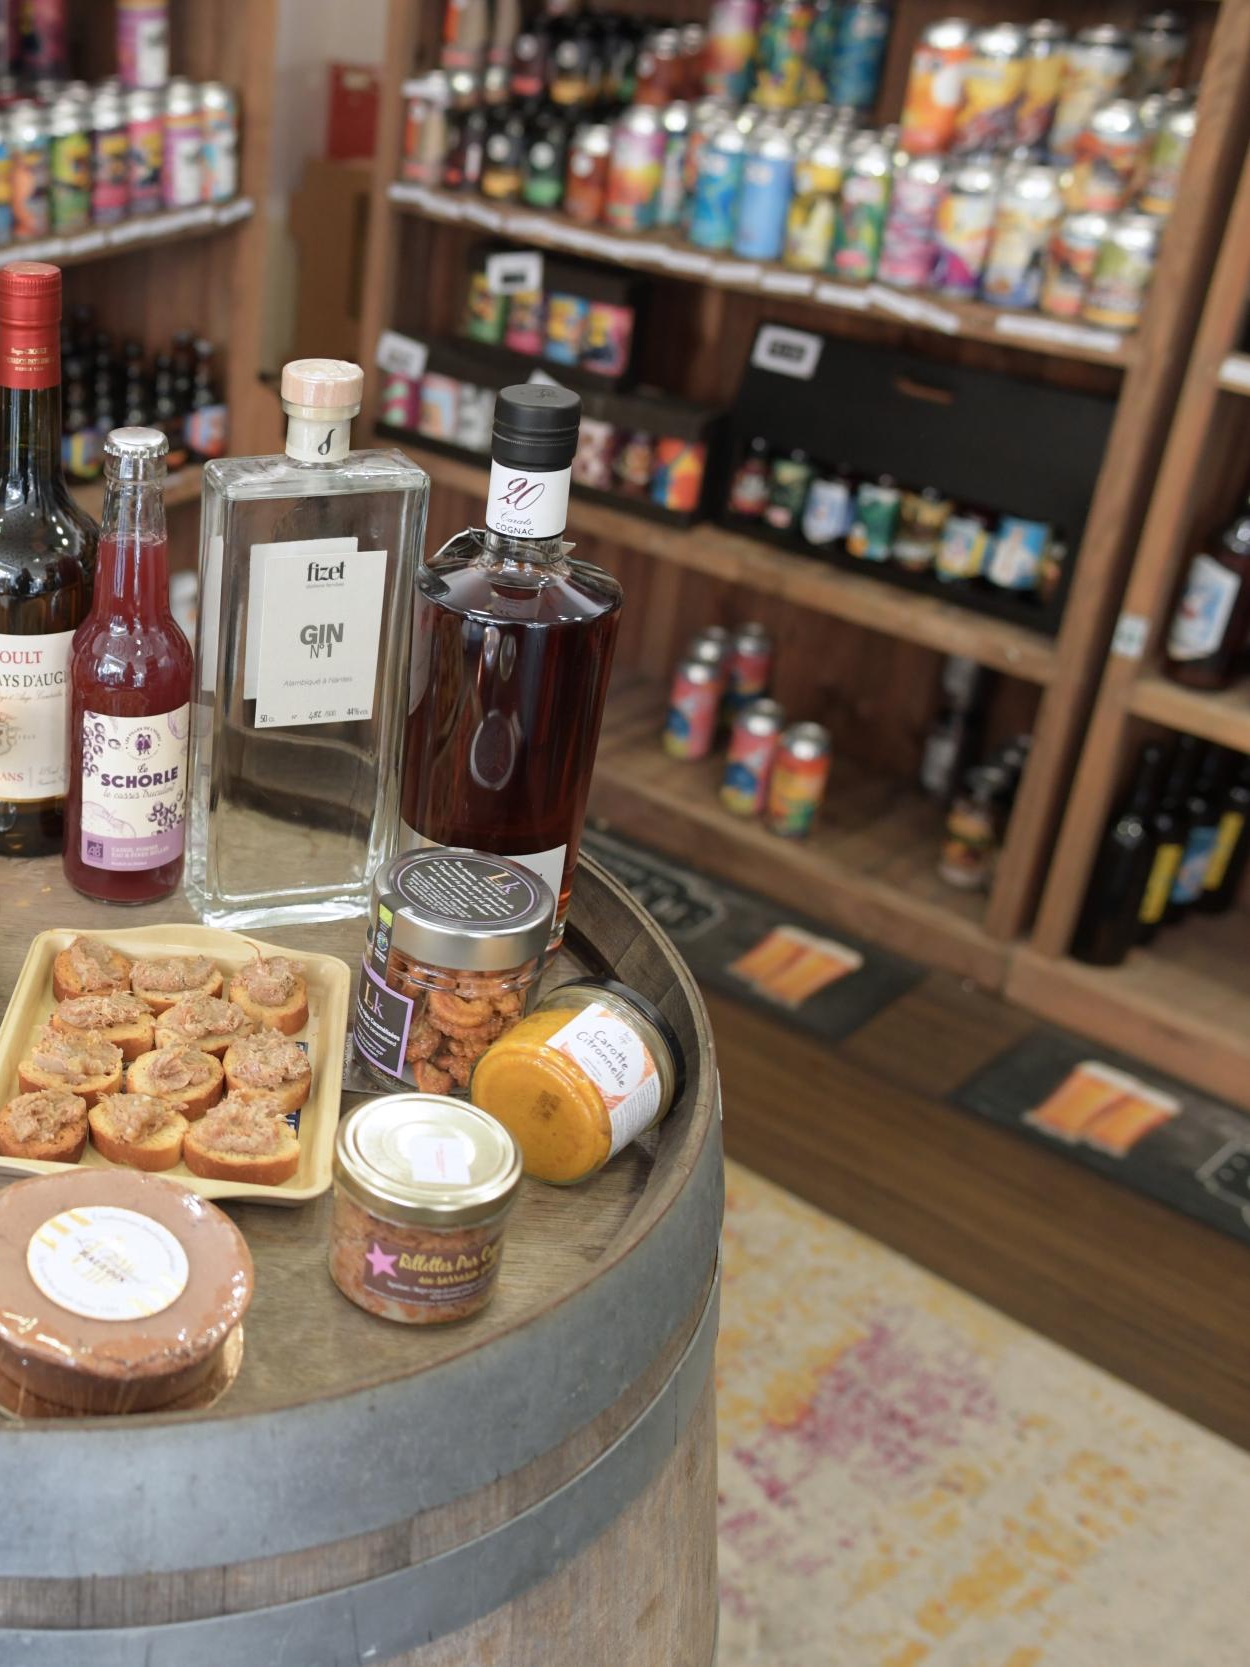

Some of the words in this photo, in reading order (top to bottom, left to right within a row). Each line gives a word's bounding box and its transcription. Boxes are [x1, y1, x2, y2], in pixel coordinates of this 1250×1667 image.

[496, 477, 546, 511] 20
[495, 522, 535, 536] COGNAC
[300, 623, 344, 645] GIN
[2, 771, 25, 782] ANS
[101, 765, 179, 789] SCHORLE
[576, 1031, 625, 1088] Citronnelle
[594, 1030, 628, 1071] Carotte
